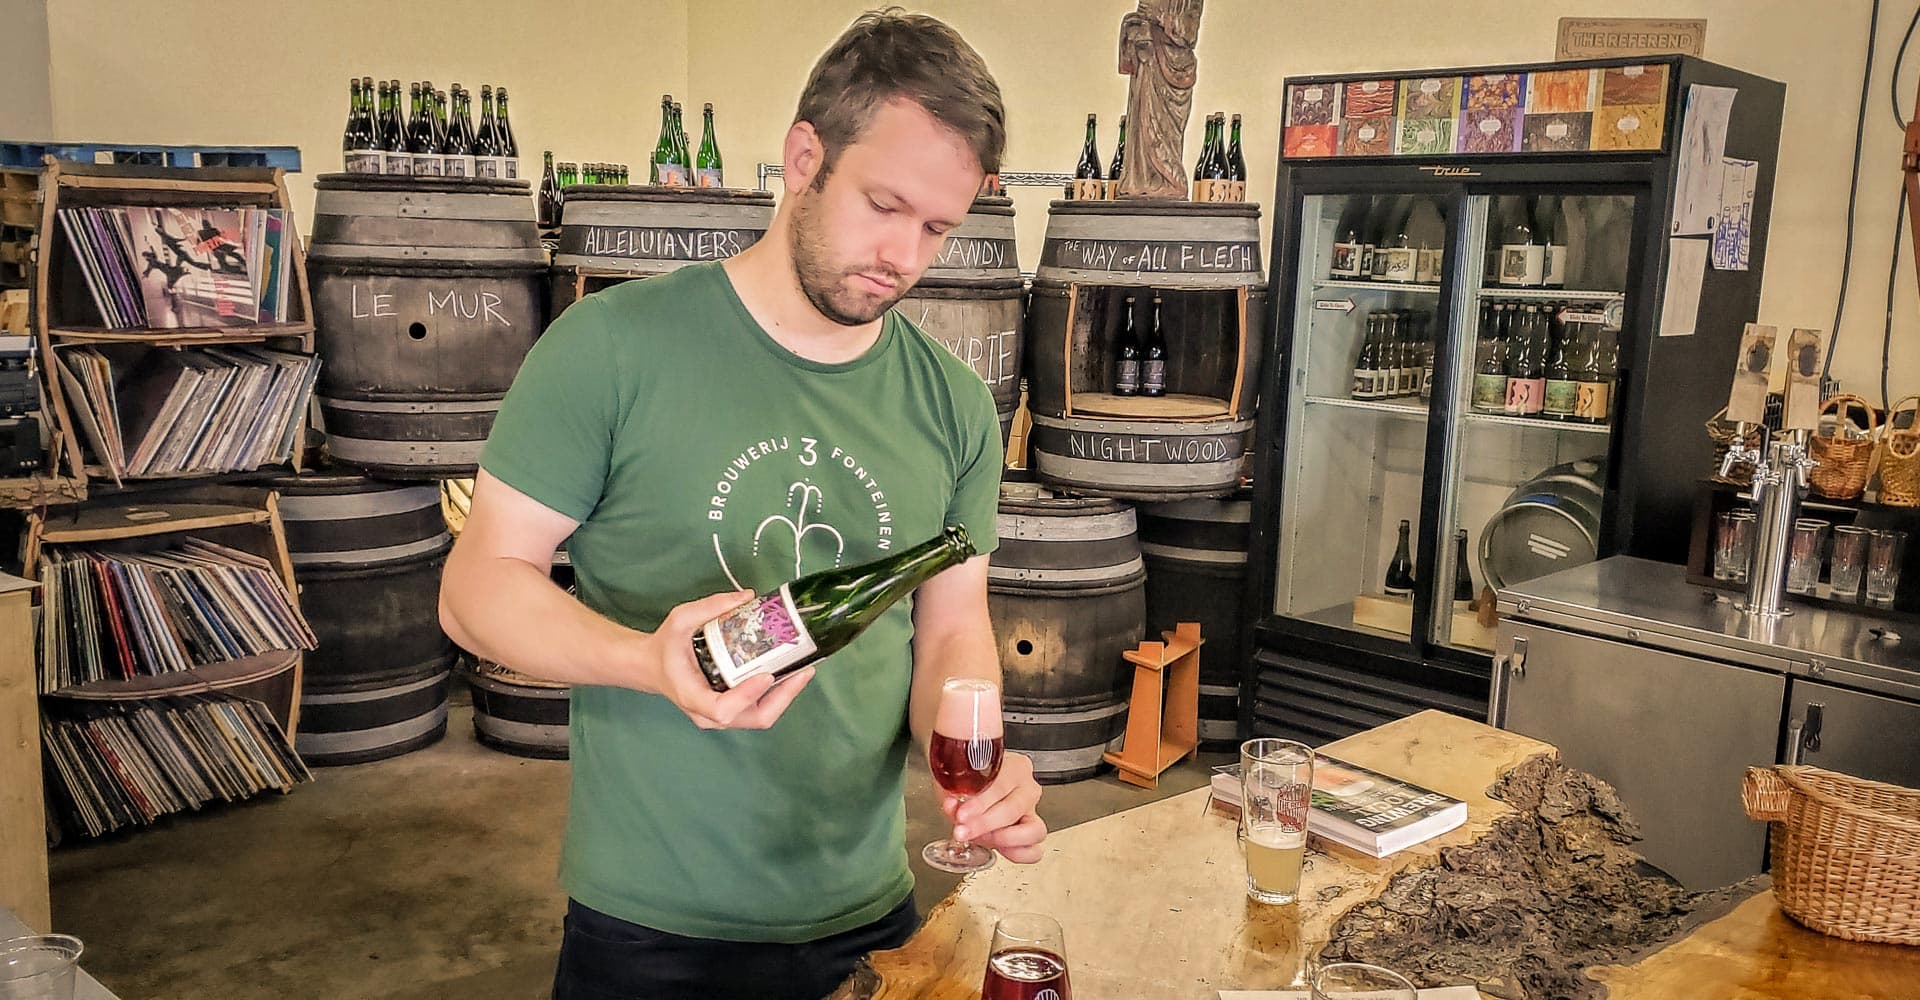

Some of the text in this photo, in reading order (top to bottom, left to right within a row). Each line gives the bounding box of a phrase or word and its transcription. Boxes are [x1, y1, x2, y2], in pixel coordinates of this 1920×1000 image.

[1573, 32, 1692, 48] THE REFEREND
[1064, 240, 1081, 251] THE
[1082, 242, 1117, 271] WAY
[1137, 245, 1168, 274] ALL
[1181, 245, 1251, 271] FLESH
[352, 285, 511, 326] LE MUR
[1071, 434, 1229, 462] NIGHTWOOD
[708, 437, 892, 550] BROUWERIJ 3 FONTEINEN
[1350, 791, 1417, 816] LOCAL
[1355, 793, 1448, 827] BREWING
